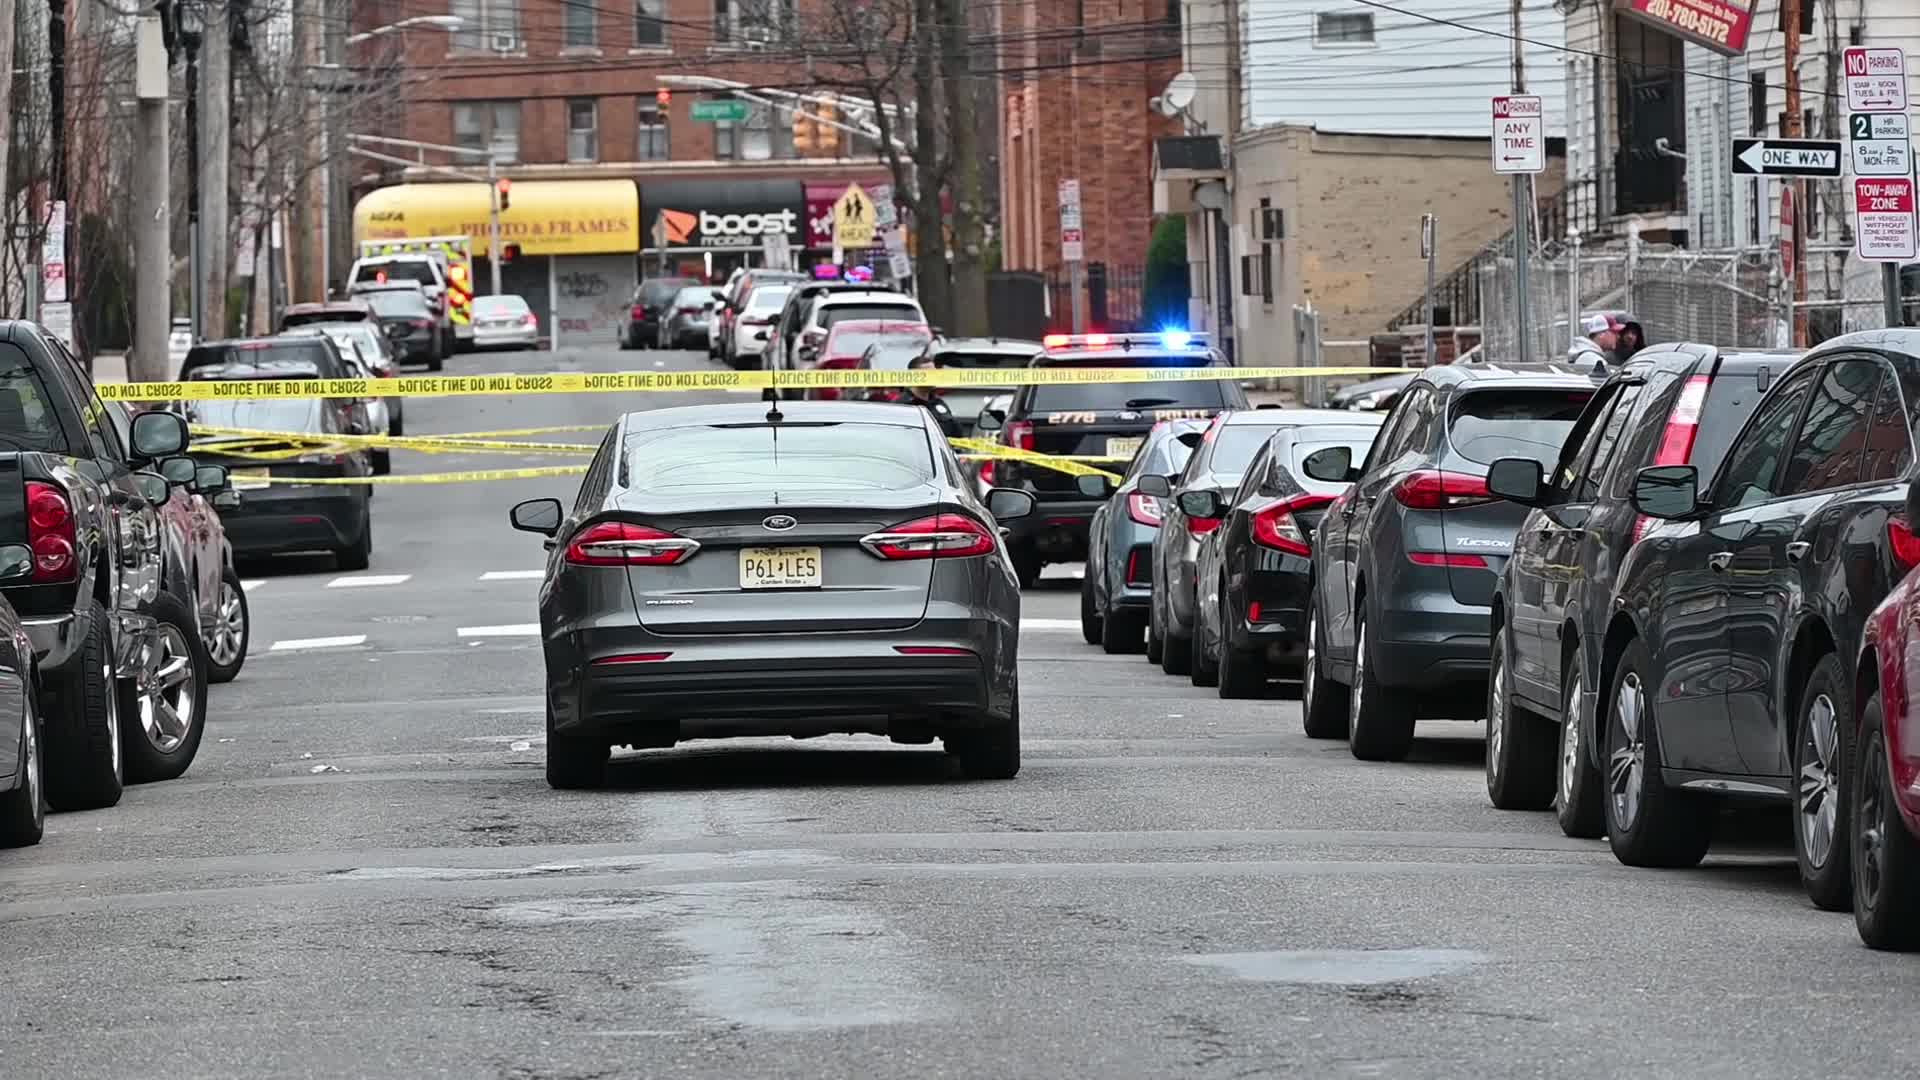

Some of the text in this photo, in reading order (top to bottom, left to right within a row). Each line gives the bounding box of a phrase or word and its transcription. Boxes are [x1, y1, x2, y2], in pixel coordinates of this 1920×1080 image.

[1645, 0, 1730, 43] 201-780-5172
[1848, 54, 1898, 74] NO PARKING
[1494, 100, 1539, 114] NO PARKING
[1504, 123, 1530, 134] ANY
[1856, 116, 1868, 137] 2
[1502, 138, 1534, 148] TIME
[1762, 150, 1829, 165] ONE WAY
[1858, 184, 1908, 197] TOW-AWAY
[1870, 197, 1899, 210] ZONE
[549, 218, 630, 233] FRAMES
[699, 208, 798, 235] boost
[700, 236, 754, 246] mobile
[1048, 412, 1096, 424] 2778
[1154, 410, 1209, 421] POLICE
[1456, 537, 1512, 548] TUCSON
